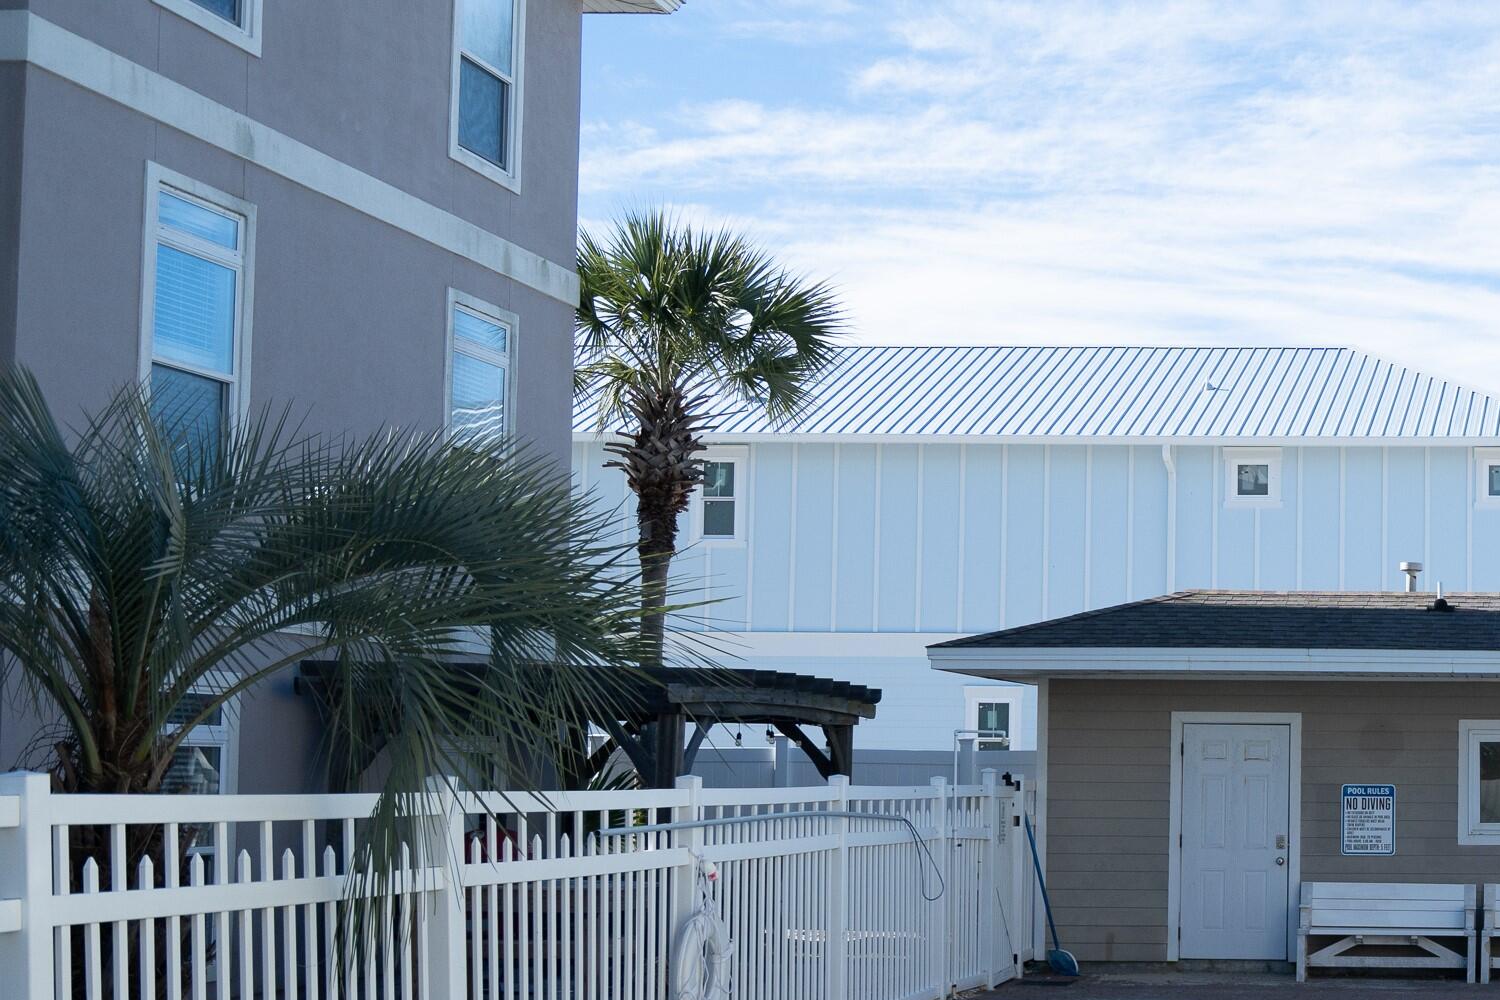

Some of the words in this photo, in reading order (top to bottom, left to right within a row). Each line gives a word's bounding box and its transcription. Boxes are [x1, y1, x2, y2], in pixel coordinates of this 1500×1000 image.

[1347, 787, 1366, 795] POOL
[1367, 787, 1390, 795] RULES
[1346, 797, 1358, 811] NO
[1361, 797, 1391, 811] DIVING
